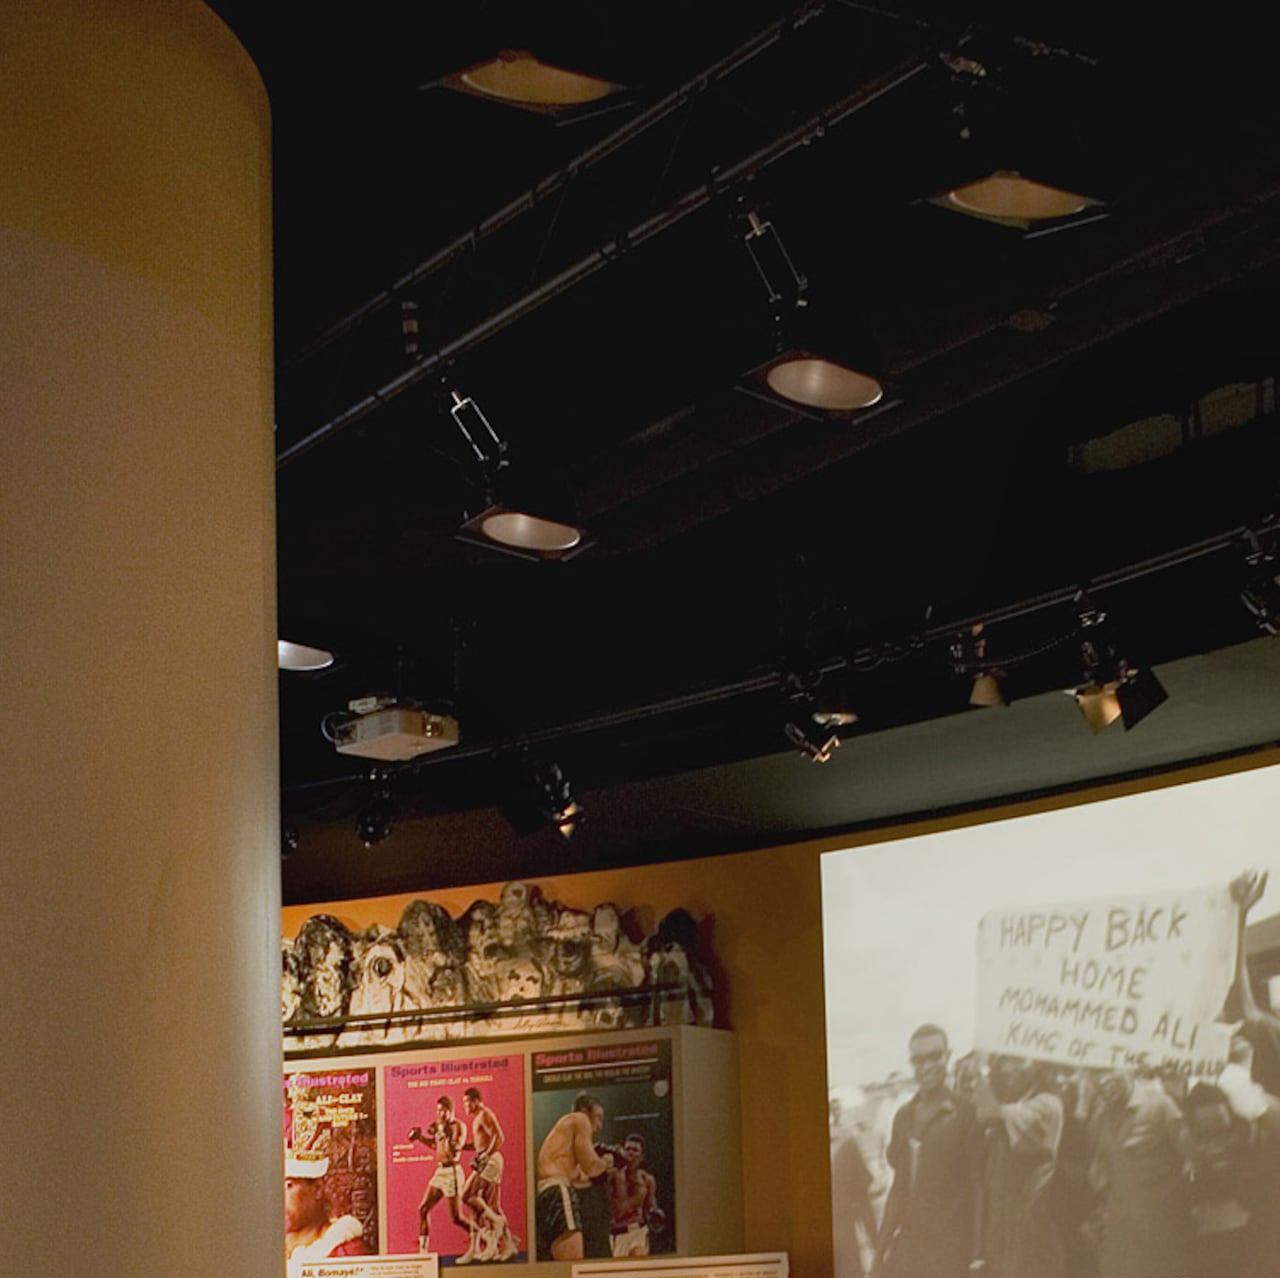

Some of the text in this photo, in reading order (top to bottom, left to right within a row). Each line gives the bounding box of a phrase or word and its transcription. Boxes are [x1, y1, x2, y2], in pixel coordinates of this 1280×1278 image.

[999, 906, 1187, 953] HAPPY BACK
[1059, 957, 1149, 1000] HOME
[999, 985, 1198, 1051] MOHAMMED ALI
[536, 1044, 658, 1067] Sports Illustrated
[1005, 1022, 1061, 1051] KING
[1069, 1037, 1097, 1060] OF
[391, 1056, 510, 1079] Sports Illustrated
